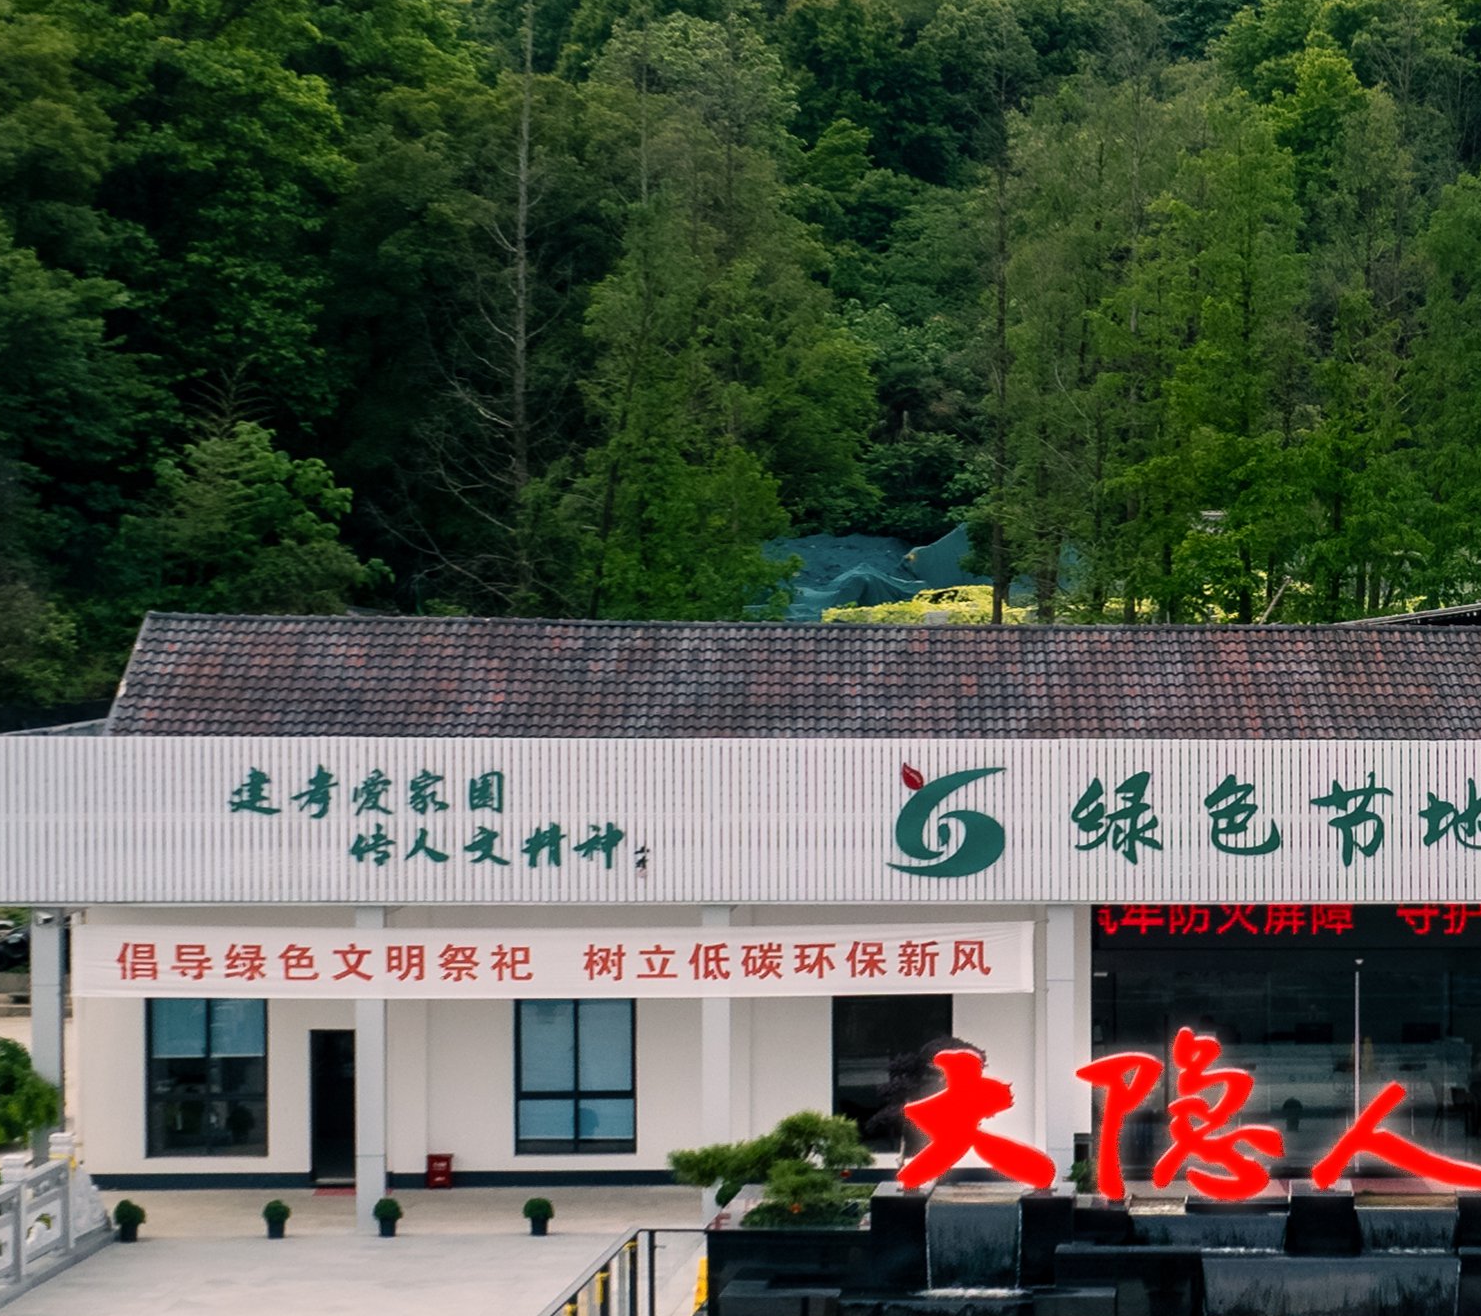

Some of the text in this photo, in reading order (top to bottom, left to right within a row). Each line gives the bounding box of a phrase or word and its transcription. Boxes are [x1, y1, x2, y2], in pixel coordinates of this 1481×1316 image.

[116, 939, 993, 982] 倡导绿色文明祭祀 树立低碳环保新风
